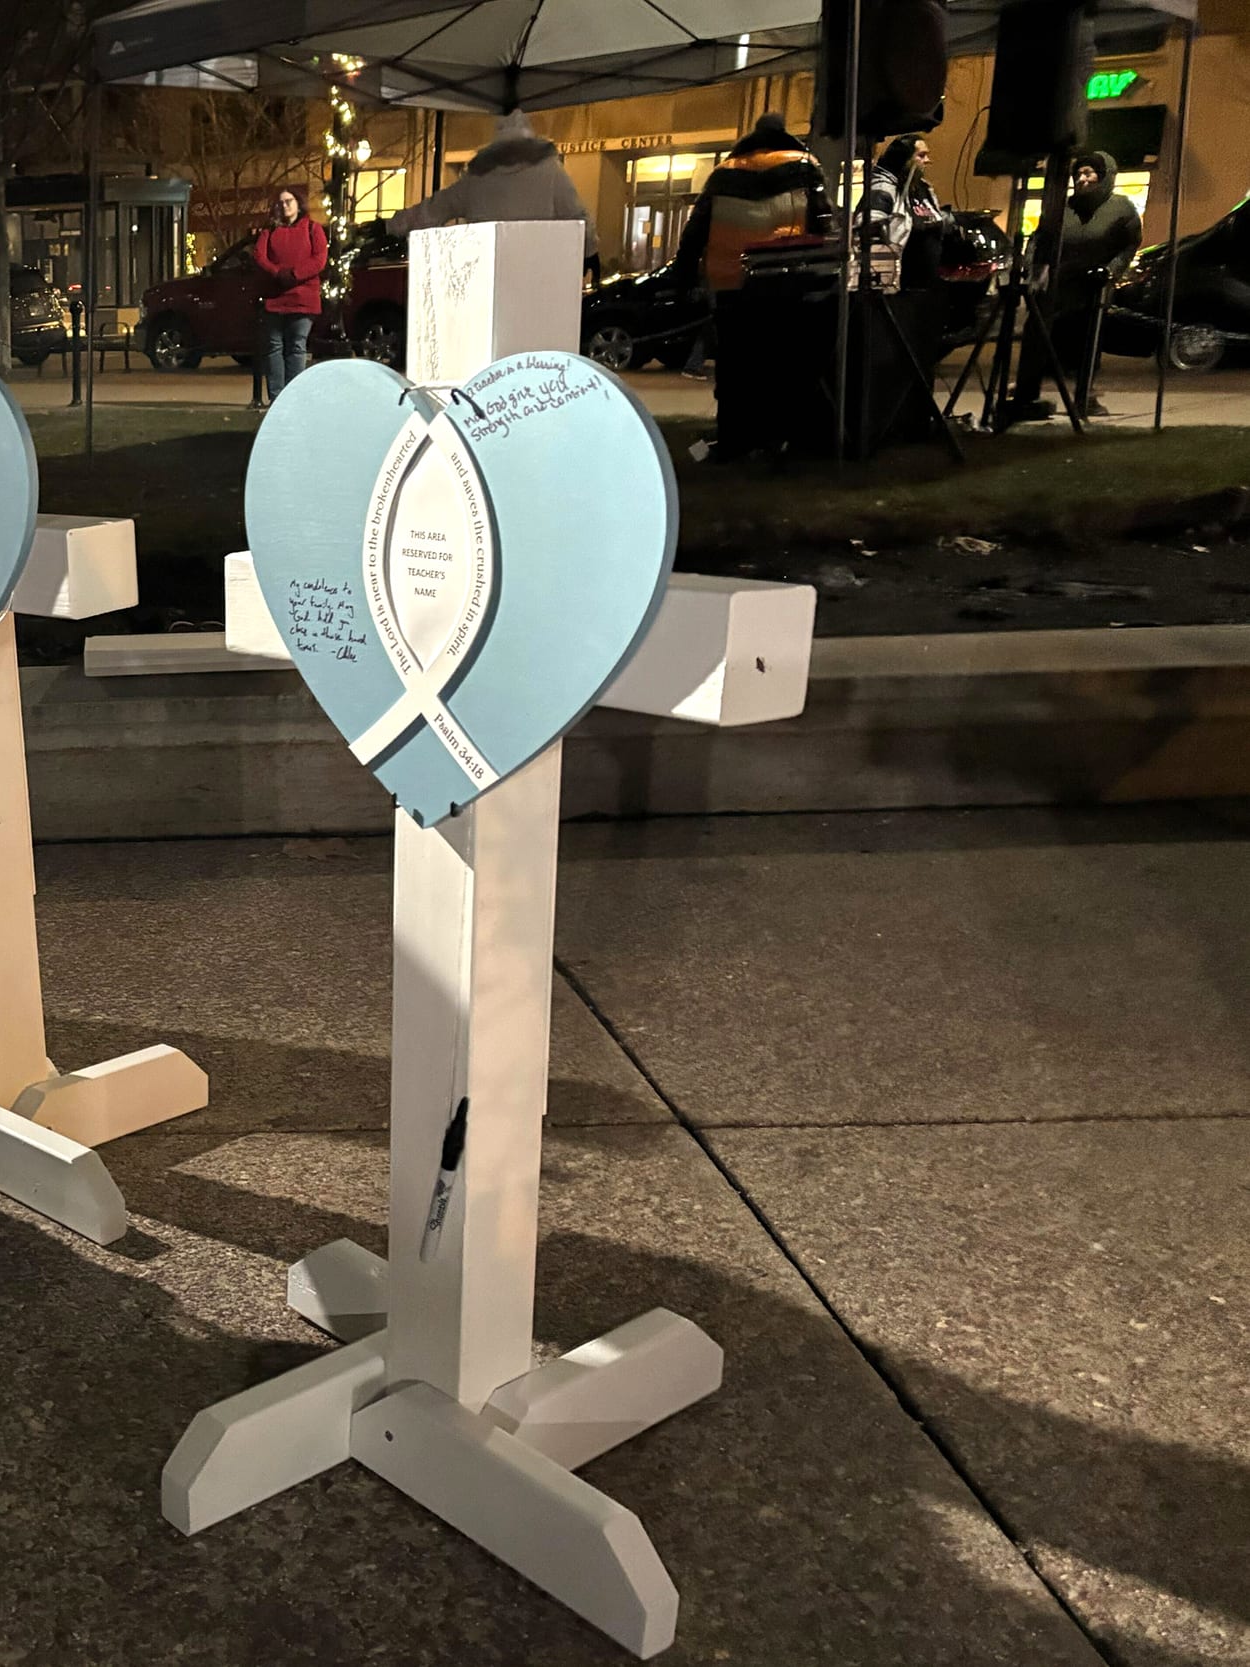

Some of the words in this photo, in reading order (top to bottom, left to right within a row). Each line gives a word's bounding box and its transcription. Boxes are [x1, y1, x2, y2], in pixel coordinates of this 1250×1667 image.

[560, 140, 607, 153] USTICE
[622, 135, 673, 149] CENTER
[486, 394, 508, 415] God
[508, 386, 536, 410] give
[537, 378, 569, 405] you
[451, 452, 469, 478] and
[370, 430, 417, 526] brokenhearted
[462, 479, 479, 518] saves
[367, 528, 379, 550] the
[410, 529, 426, 540] THIS
[427, 532, 447, 542] AREA
[473, 520, 485, 545] the
[368, 554, 377, 567] to
[401, 548, 438, 561] RESERVED
[438, 552, 454, 562] FOR
[407, 567, 446, 580] TEACHER'S
[471, 547, 486, 608] crushed
[370, 571, 382, 602] near
[413, 587, 437, 598] NAME
[376, 603, 386, 617] is
[465, 608, 479, 623] in
[379, 617, 399, 650] Lord
[446, 623, 469, 657] spirit.
[395, 649, 412, 676] The
[433, 712, 460, 750] Psalm
[457, 746, 485, 780] 34:18
